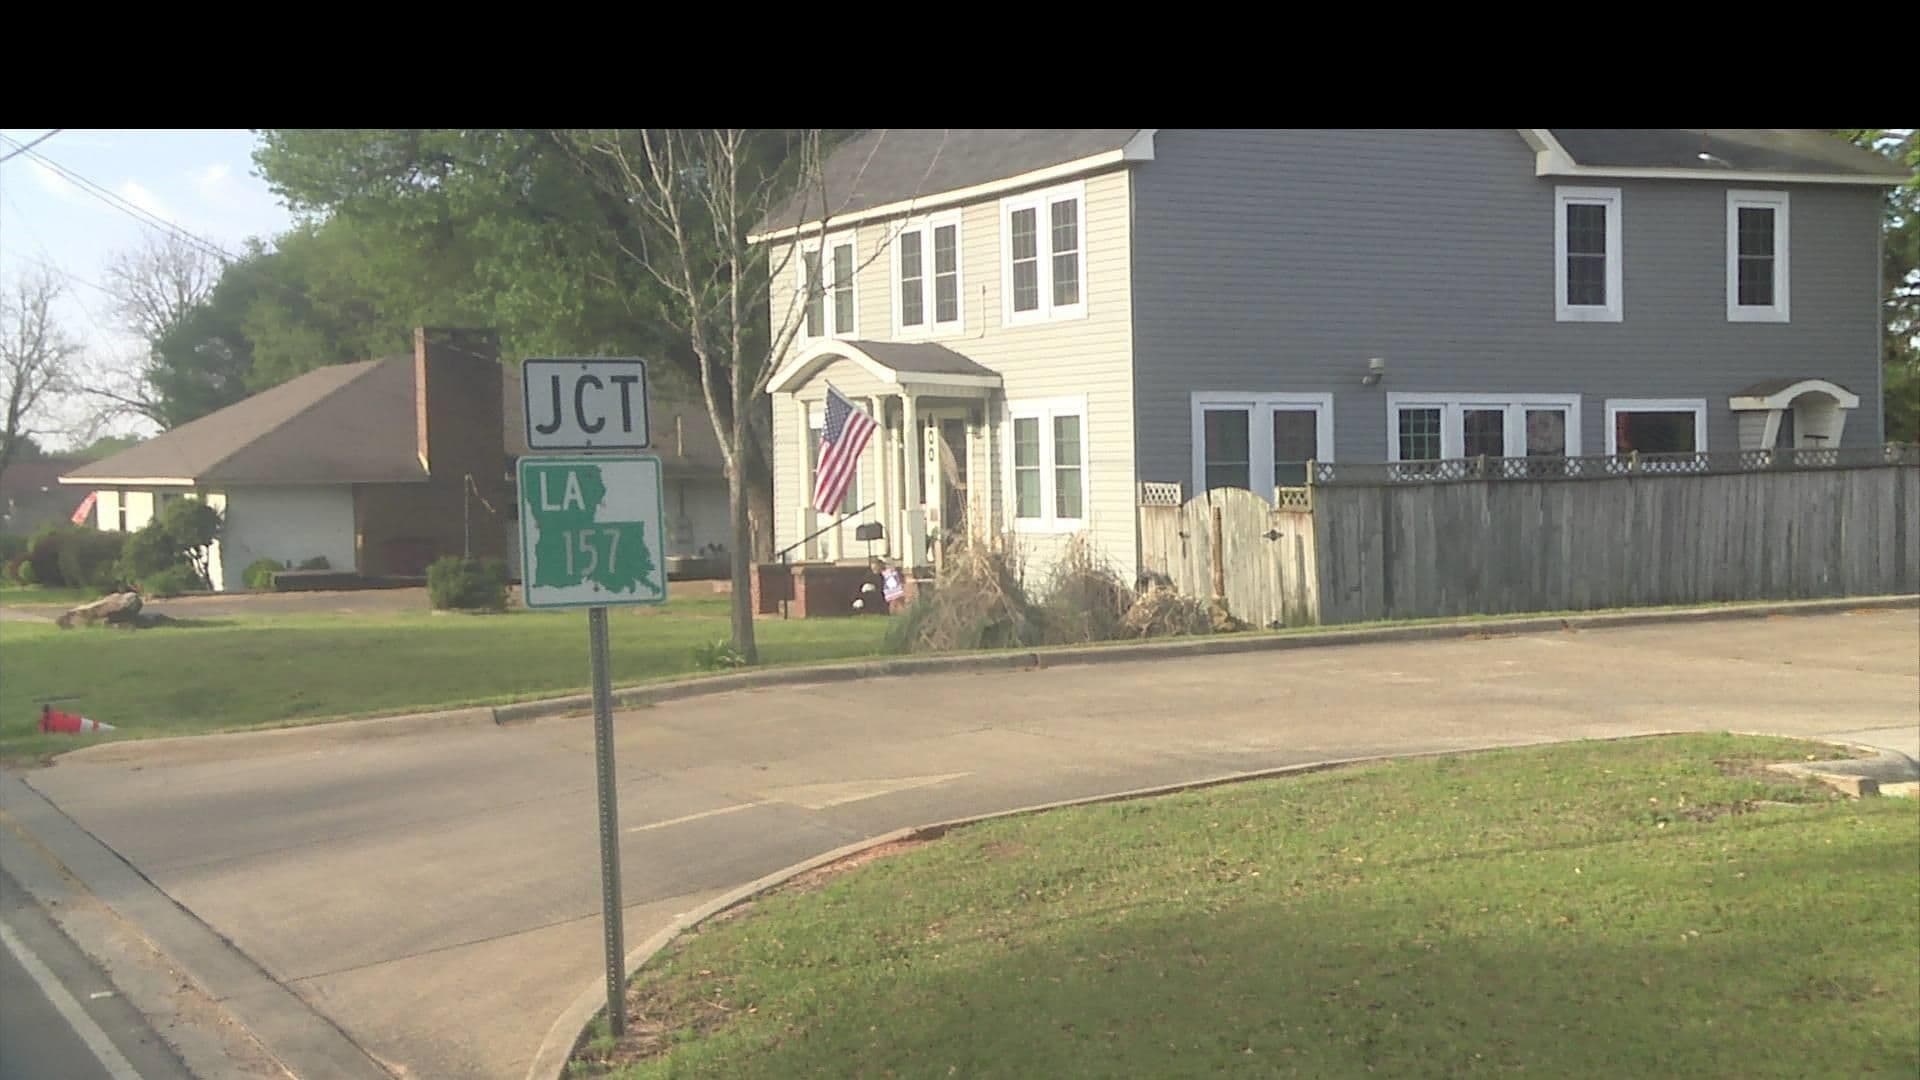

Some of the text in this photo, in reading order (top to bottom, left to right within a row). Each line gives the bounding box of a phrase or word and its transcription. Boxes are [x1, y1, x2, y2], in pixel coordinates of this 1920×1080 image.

[535, 374, 638, 435] JCT
[539, 471, 585, 512] LA
[562, 528, 621, 577] 157
